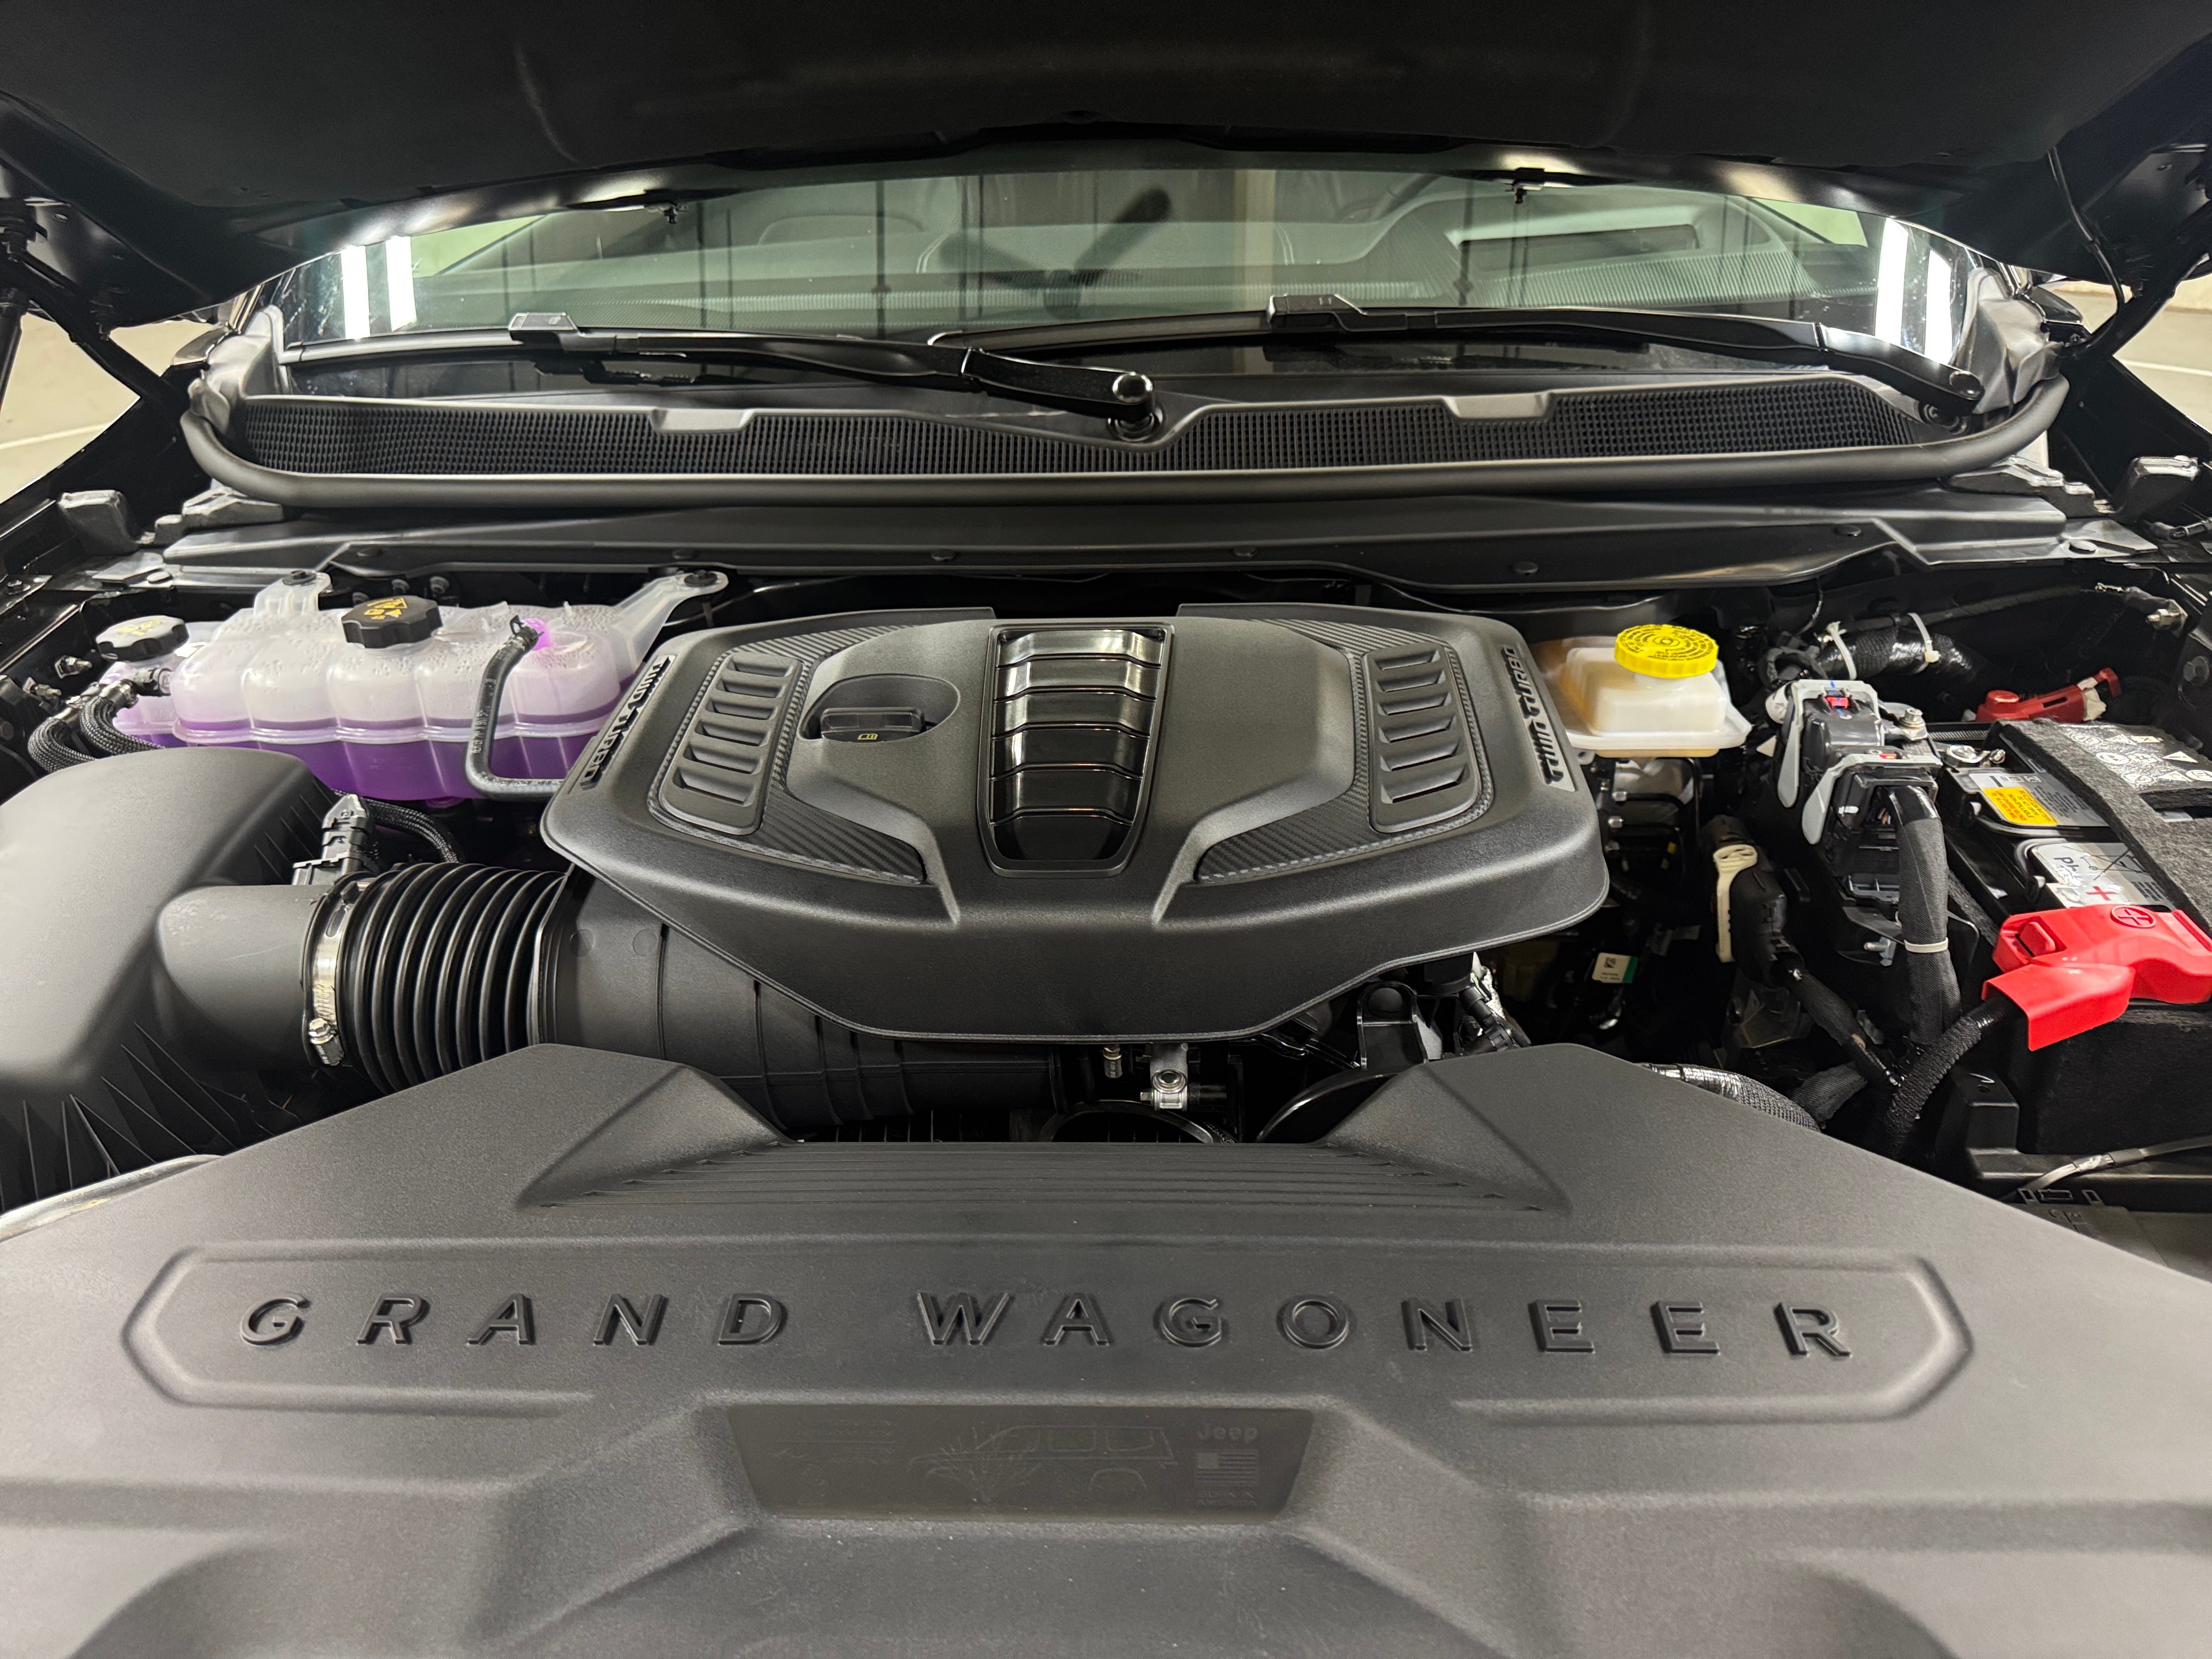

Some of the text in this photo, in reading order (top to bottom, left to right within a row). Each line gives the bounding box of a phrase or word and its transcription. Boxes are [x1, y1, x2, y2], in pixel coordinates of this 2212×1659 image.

[580, 656, 670, 788] TWIN TURBO
[1502, 645, 1564, 785] TWIN TURBO
[240, 1291, 1853, 1357] GRAND WAGONEER
[1197, 1423, 1259, 1444] Jeep
